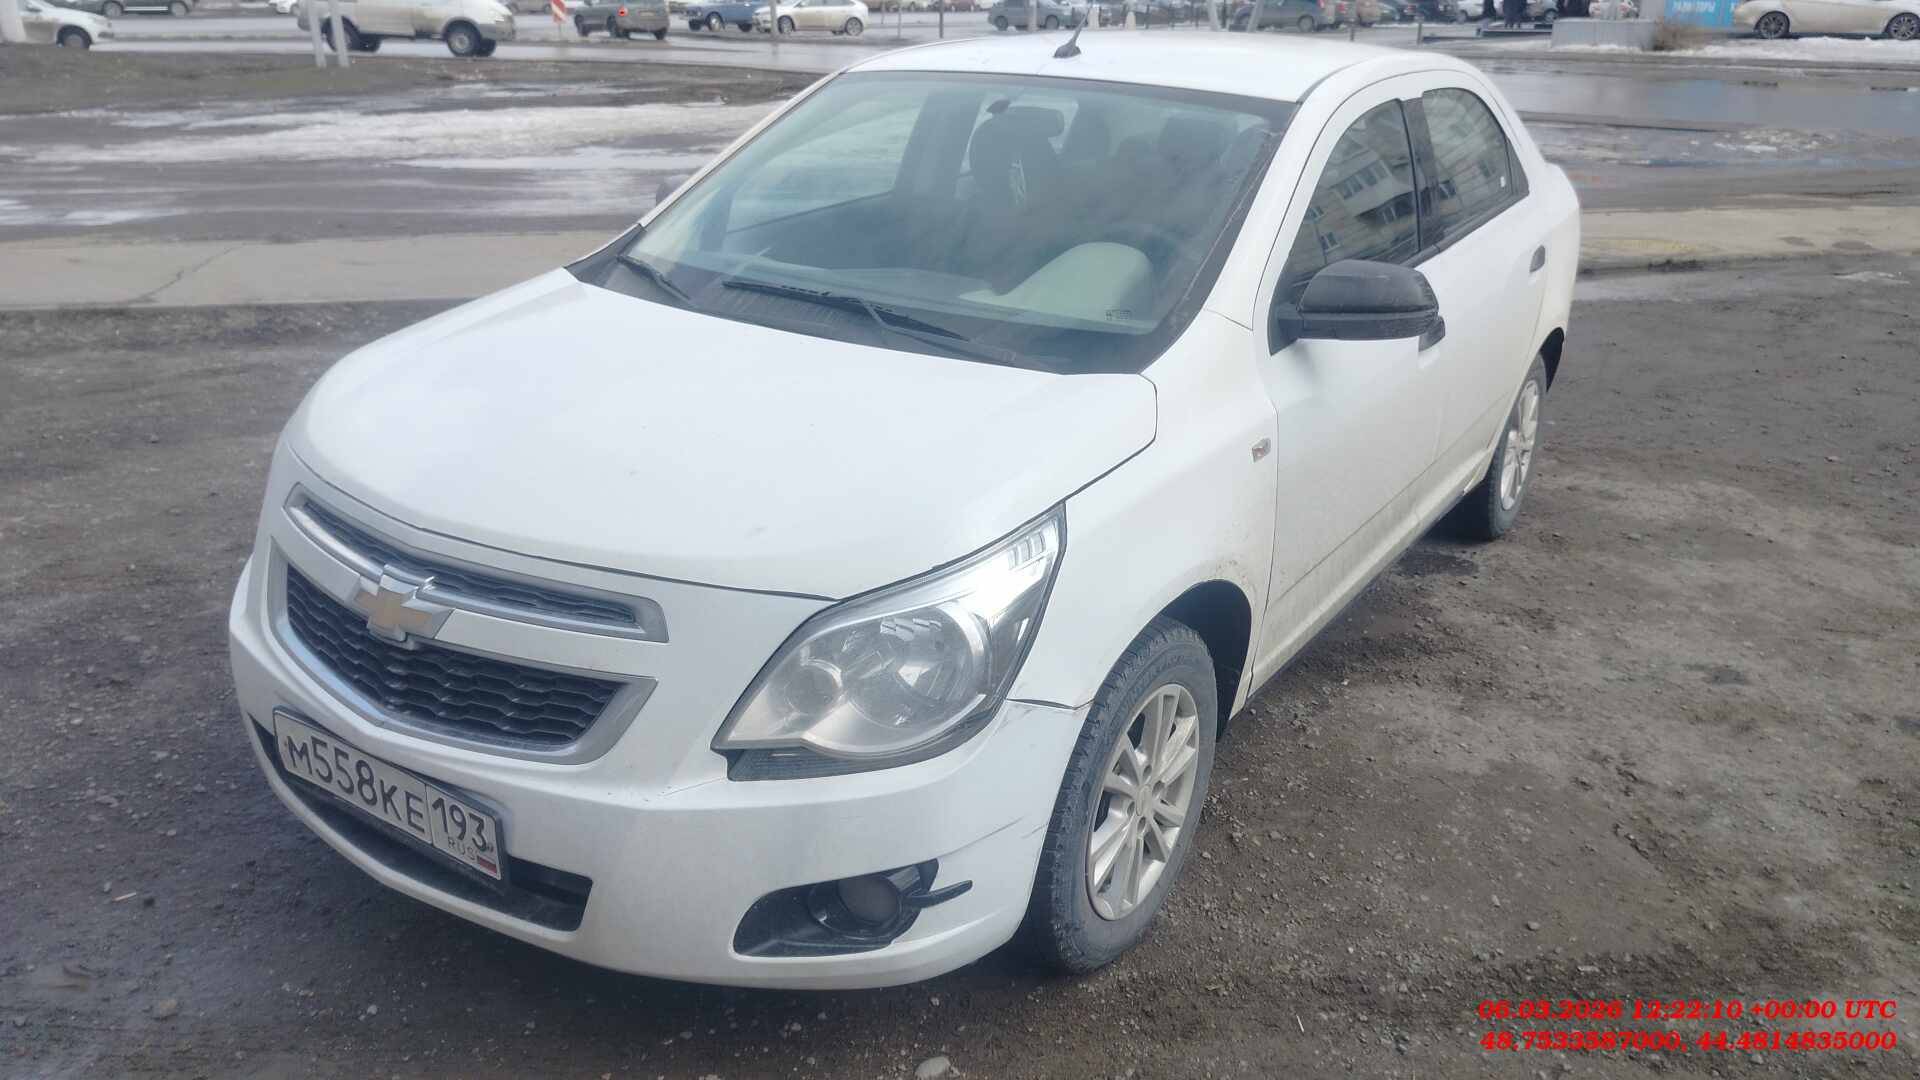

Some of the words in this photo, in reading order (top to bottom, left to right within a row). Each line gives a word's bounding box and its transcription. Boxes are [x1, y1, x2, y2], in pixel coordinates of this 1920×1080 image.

[286, 735, 426, 834] М558КЕ
[431, 796, 488, 852] 193
[447, 836, 476, 861] RUS
